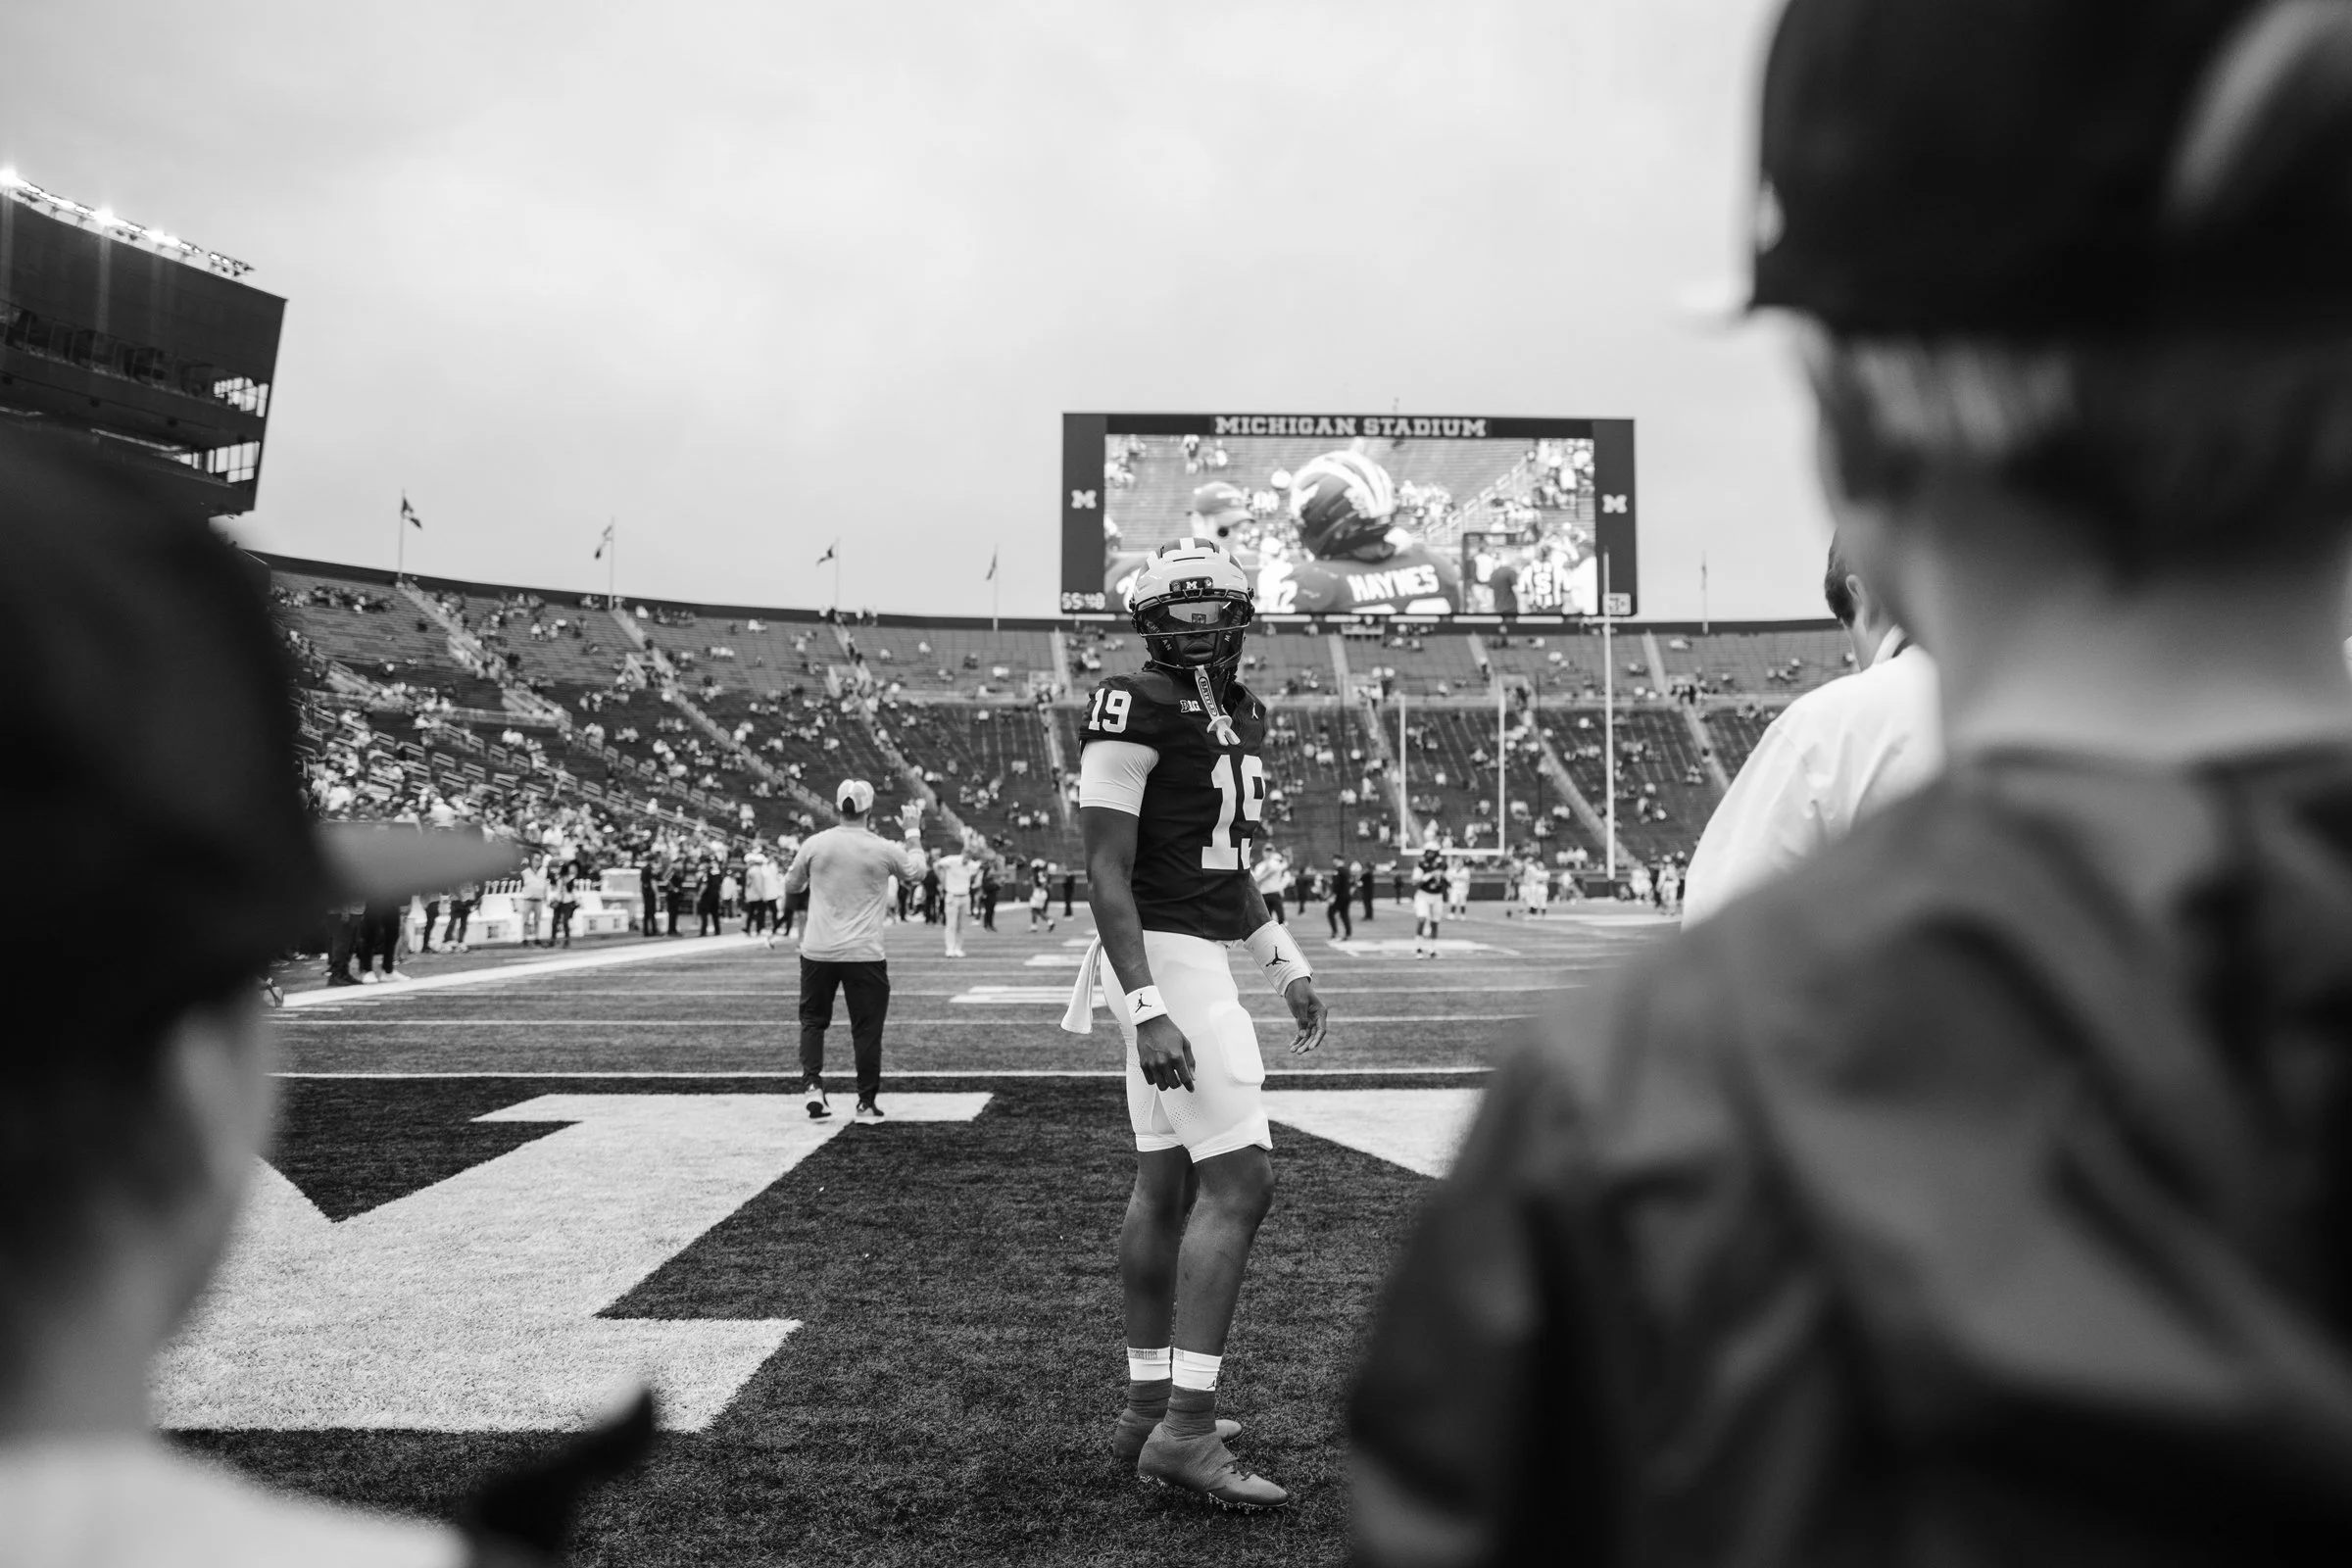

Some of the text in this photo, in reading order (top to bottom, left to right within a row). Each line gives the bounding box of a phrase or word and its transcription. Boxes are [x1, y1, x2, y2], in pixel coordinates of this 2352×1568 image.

[1215, 416, 1487, 437] MICHIGAN STADIUM
[1071, 489, 1097, 509] M
[1603, 494, 1627, 514] M
[1347, 564, 1439, 602] HAYNES
[1088, 688, 1132, 733] 19
[1200, 680, 1218, 715] BATTLE
[1201, 754, 1265, 870] 19
